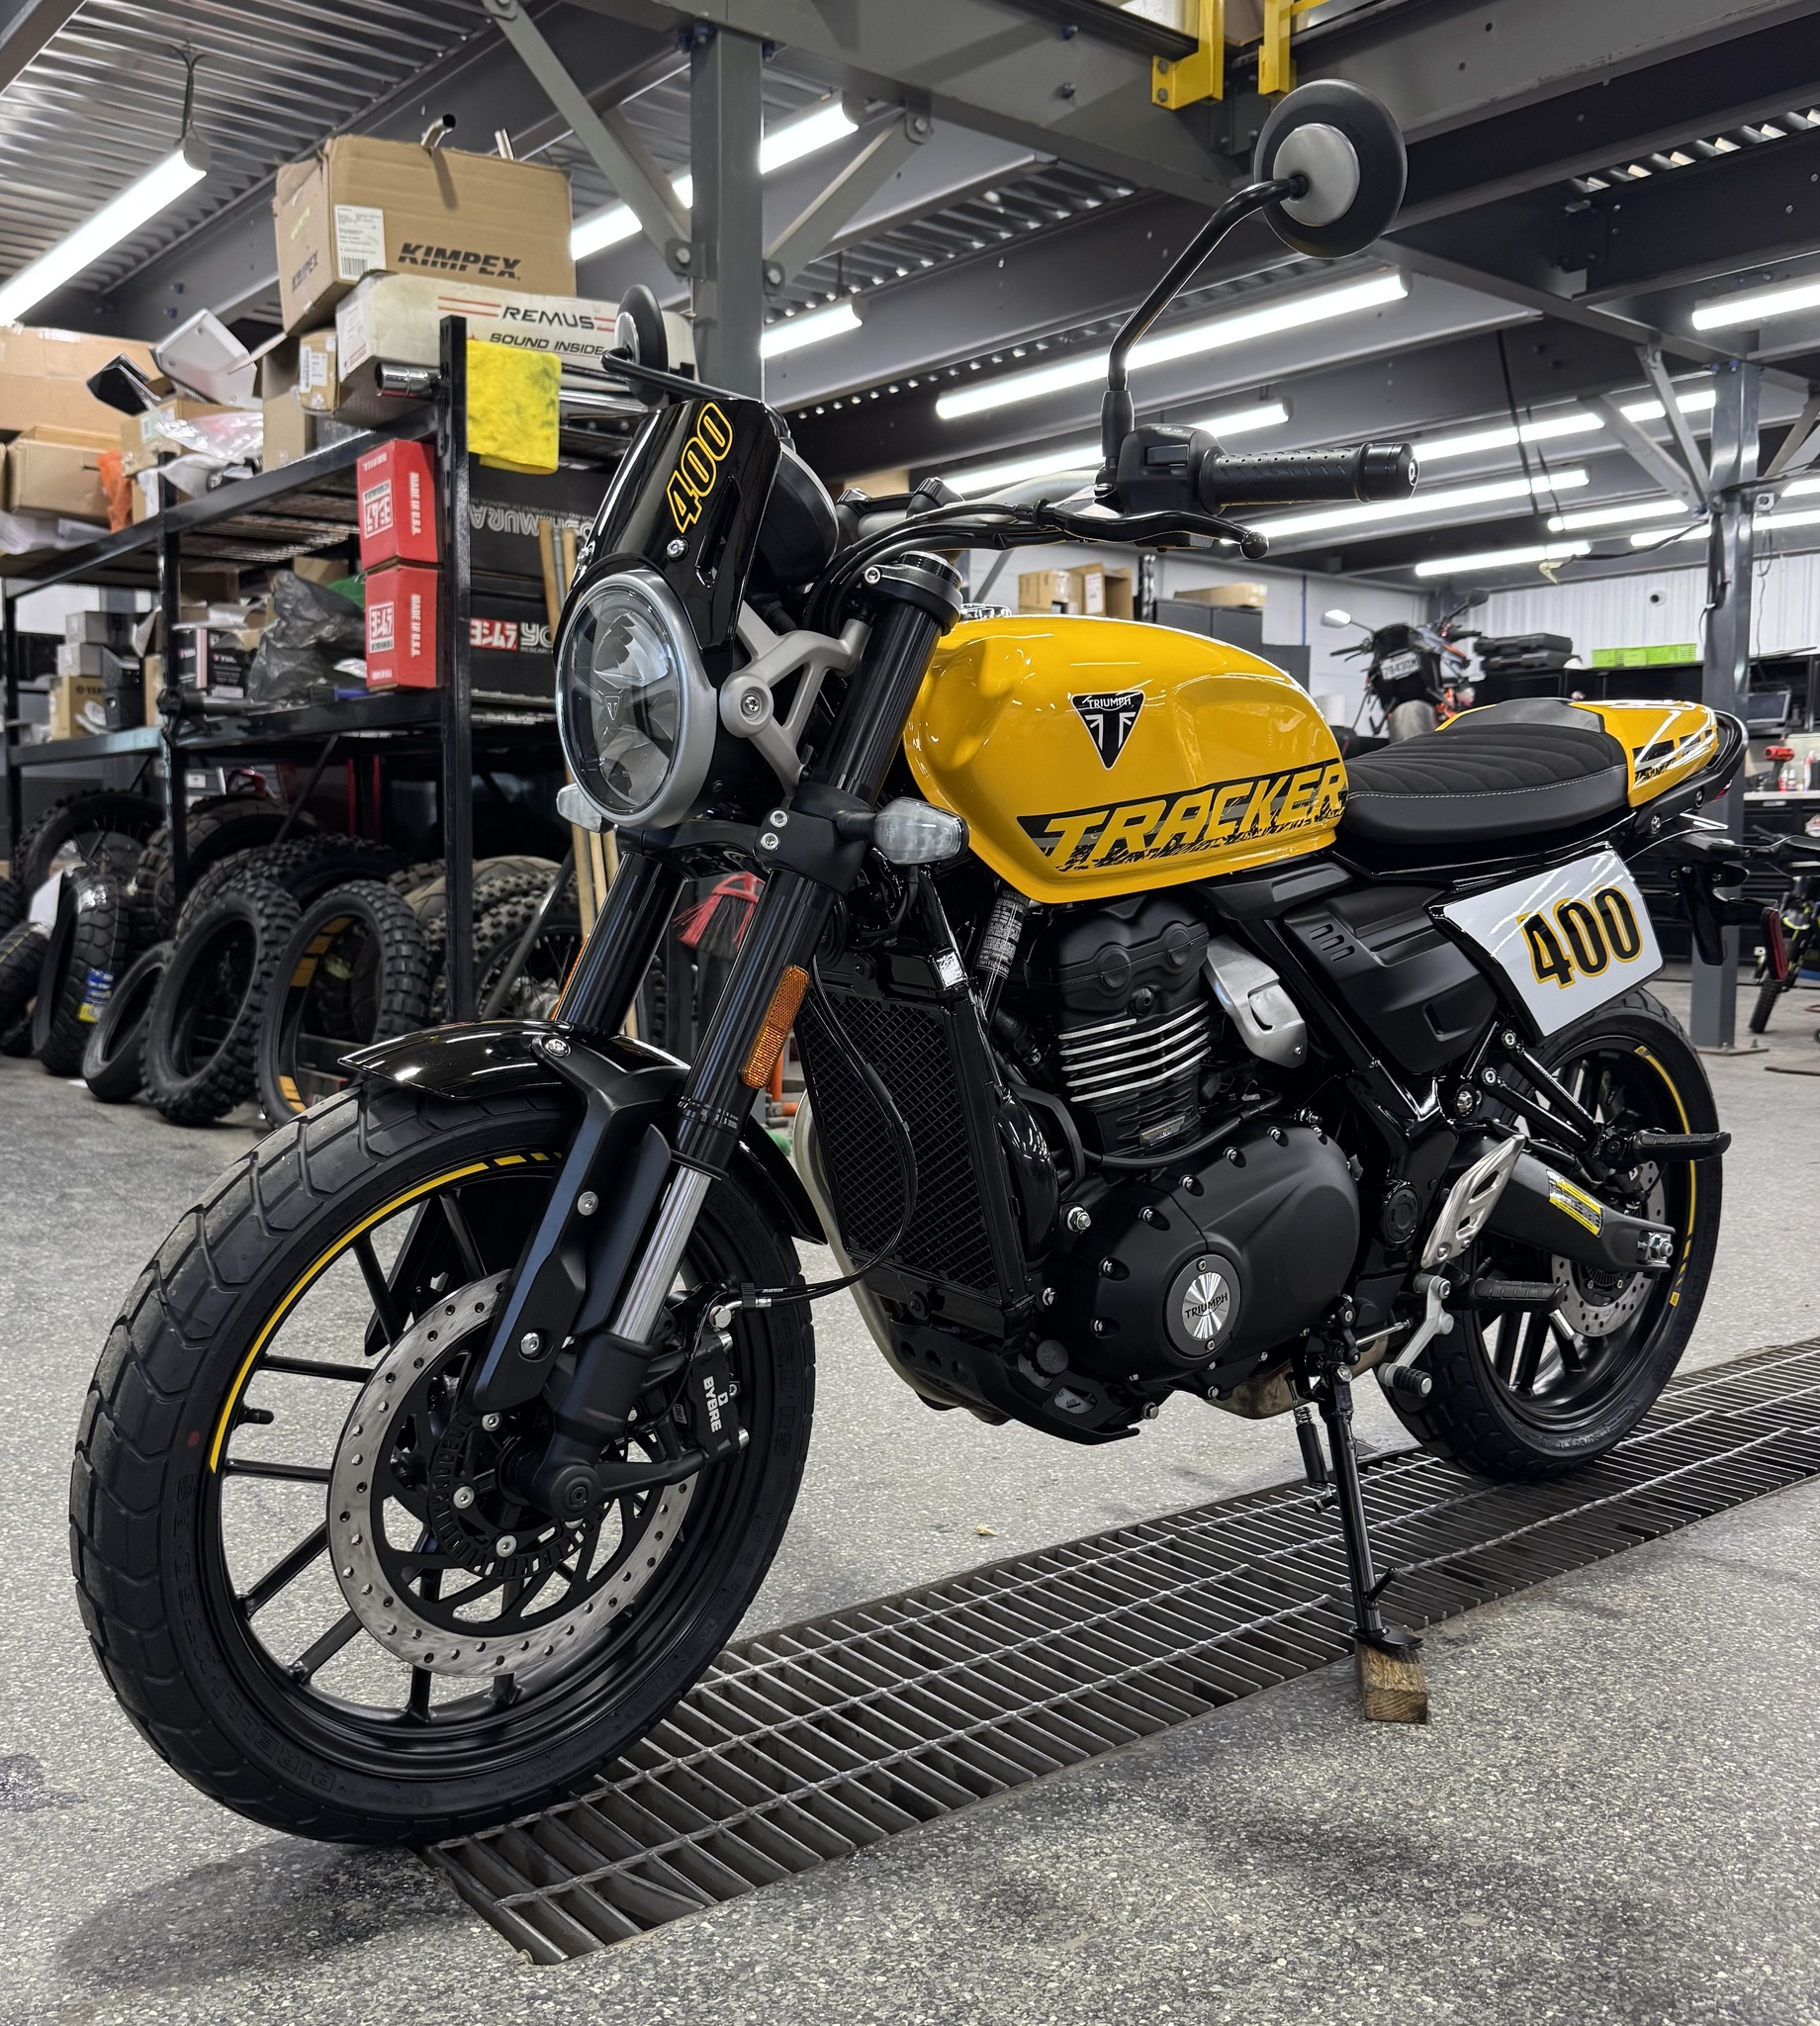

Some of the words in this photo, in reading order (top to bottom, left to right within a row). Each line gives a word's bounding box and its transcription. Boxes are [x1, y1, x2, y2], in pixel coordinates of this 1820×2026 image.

[398, 243, 522, 281] KIMPEX
[502, 307, 595, 330] REMUS
[490, 332, 550, 349] SOUND
[554, 340, 604, 356] INSIDE
[666, 402, 734, 534] 400
[1087, 696, 1132, 711] TRIUMPH
[1044, 762, 1348, 865] TRACKER
[1517, 884, 1644, 990] 400
[1185, 1292, 1228, 1319] TRIUMPH
[703, 1375, 722, 1433] BYBRE
[210, 1675, 337, 1794] PIRELLI
